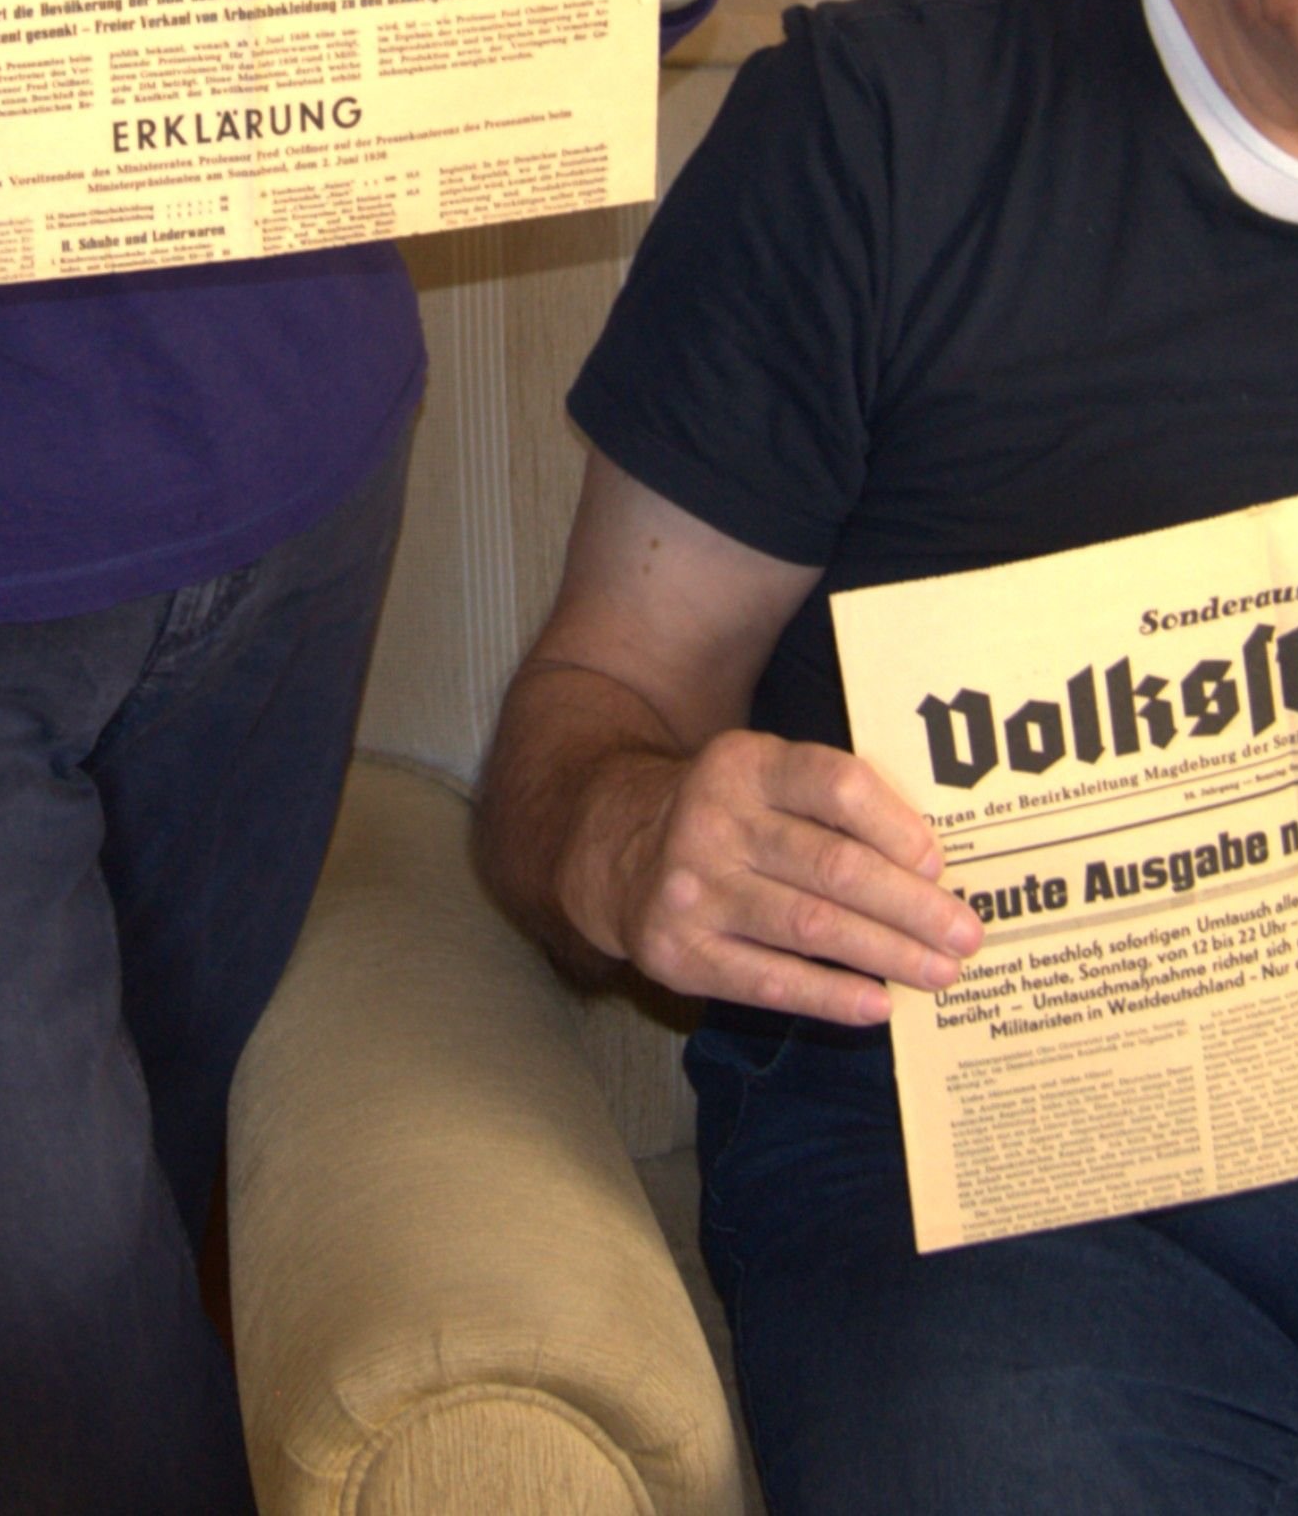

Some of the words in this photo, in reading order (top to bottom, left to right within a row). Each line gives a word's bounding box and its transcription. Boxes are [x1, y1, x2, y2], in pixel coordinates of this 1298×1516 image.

[112, 96, 362, 153] ERKLÄRUNG
[983, 801, 1012, 816] der
[1017, 773, 1139, 809] Bezirksleitung
[1143, 750, 1237, 780] Magdeburg
[1241, 742, 1268, 758] der
[953, 874, 1068, 923] eute
[1083, 830, 1269, 903] Ausgabe
[934, 981, 1018, 1009] Umtausch
[1020, 971, 1074, 991] heute,
[1078, 956, 1152, 981] Sonntag,
[1156, 947, 1188, 963] von
[1191, 938, 1208, 955] 12
[1210, 935, 1234, 951] bis
[1237, 926, 1256, 945] 22
[1259, 919, 1287, 938] Uhr
[1028, 939, 1103, 969] beschloß
[1108, 925, 1191, 953] sofortigen
[1196, 901, 1272, 933] Umtausch
[935, 1005, 1002, 1030] berührt
[1032, 964, 1206, 1010] Umtauschmaßnahme
[1211, 947, 1258, 972] richtet
[1265, 937, 1292, 958] sich
[989, 1011, 1083, 1039] Militaristen
[1086, 1005, 1103, 1020] in
[1106, 970, 1245, 1015] Westdeutschland
[1260, 961, 1289, 980] Nur
